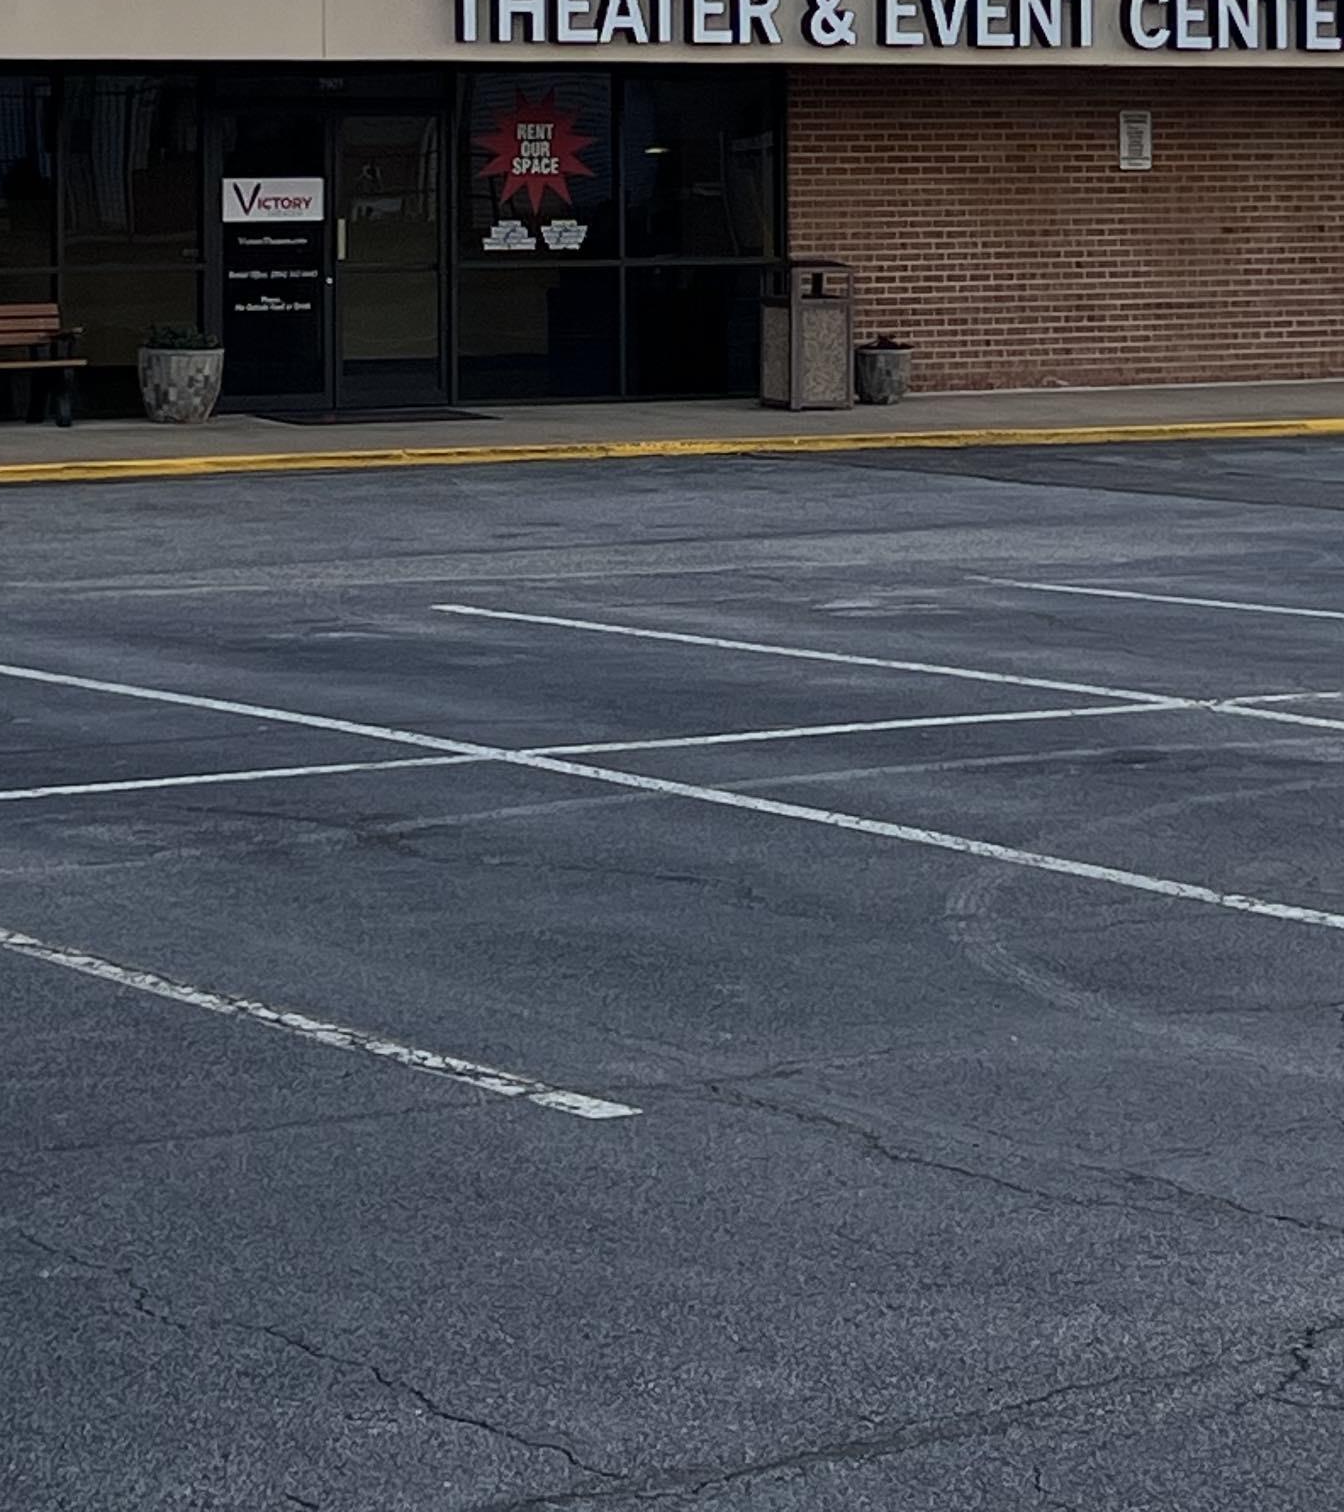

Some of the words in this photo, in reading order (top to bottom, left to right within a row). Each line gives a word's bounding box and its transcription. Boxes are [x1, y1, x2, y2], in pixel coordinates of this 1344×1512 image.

[516, 123, 555, 140] RENT
[520, 140, 551, 157] OUR
[512, 156, 560, 175] SPACE
